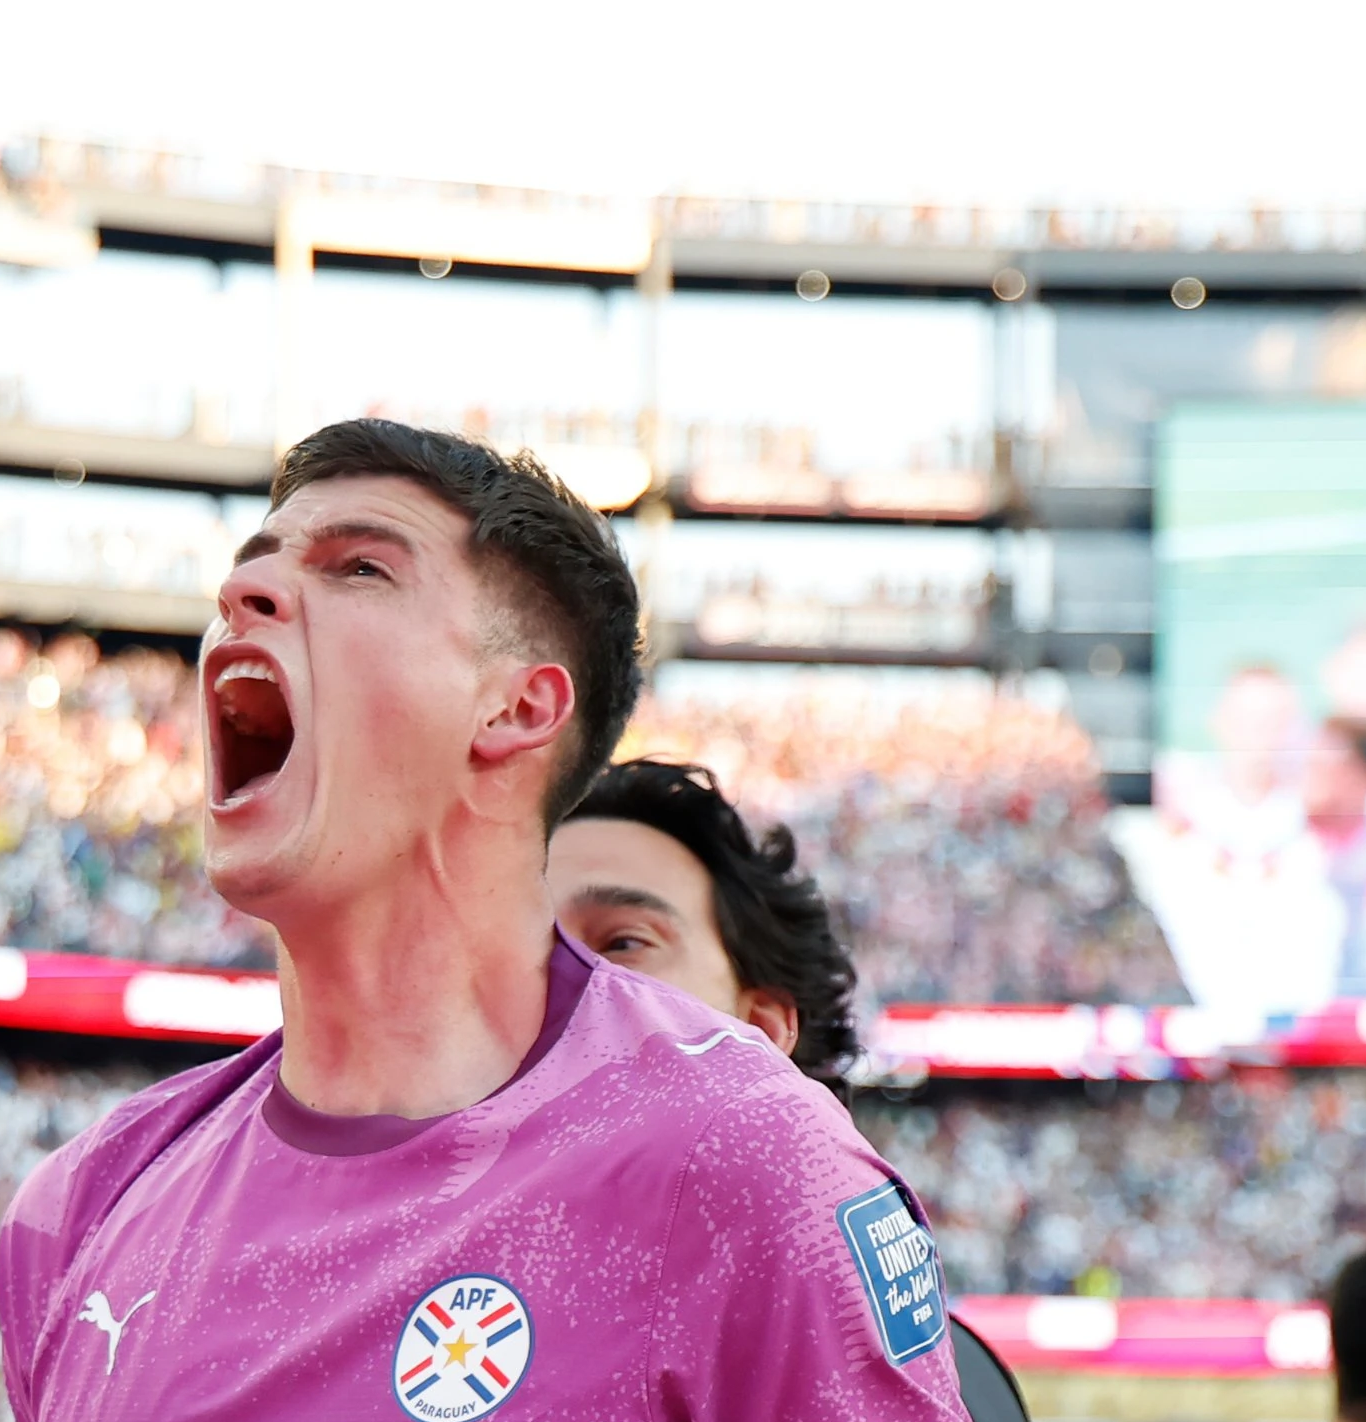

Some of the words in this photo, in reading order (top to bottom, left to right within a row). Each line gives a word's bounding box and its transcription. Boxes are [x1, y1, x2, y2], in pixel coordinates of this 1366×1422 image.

[866, 1207, 917, 1248] FOOTBA
[449, 1287, 497, 1311] APF
[885, 1282, 912, 1316] the
[911, 1303, 934, 1326] FIFA
[414, 1398, 477, 1419] PARAGUAY
